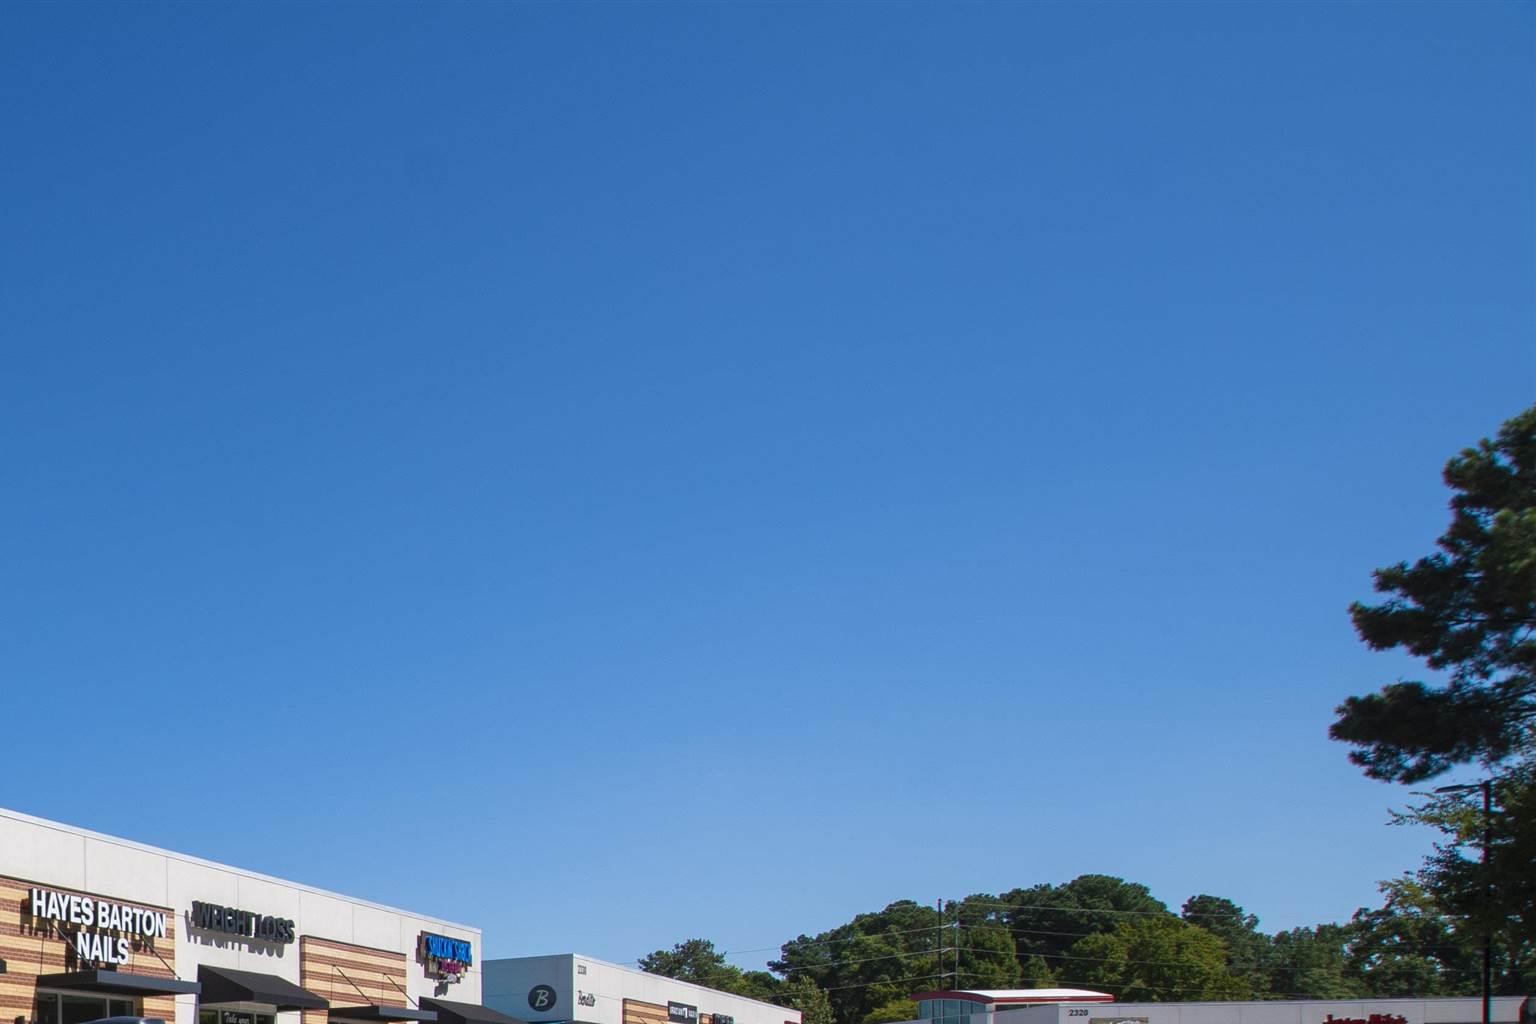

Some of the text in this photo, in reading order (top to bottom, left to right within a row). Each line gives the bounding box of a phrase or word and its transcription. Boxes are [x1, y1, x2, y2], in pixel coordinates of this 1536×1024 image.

[31, 887, 167, 938] HAYES BARTON
[192, 900, 296, 944] WEIGHT LOSS
[76, 931, 129, 965] NAILS
[1068, 1008, 1089, 1017] 2320
